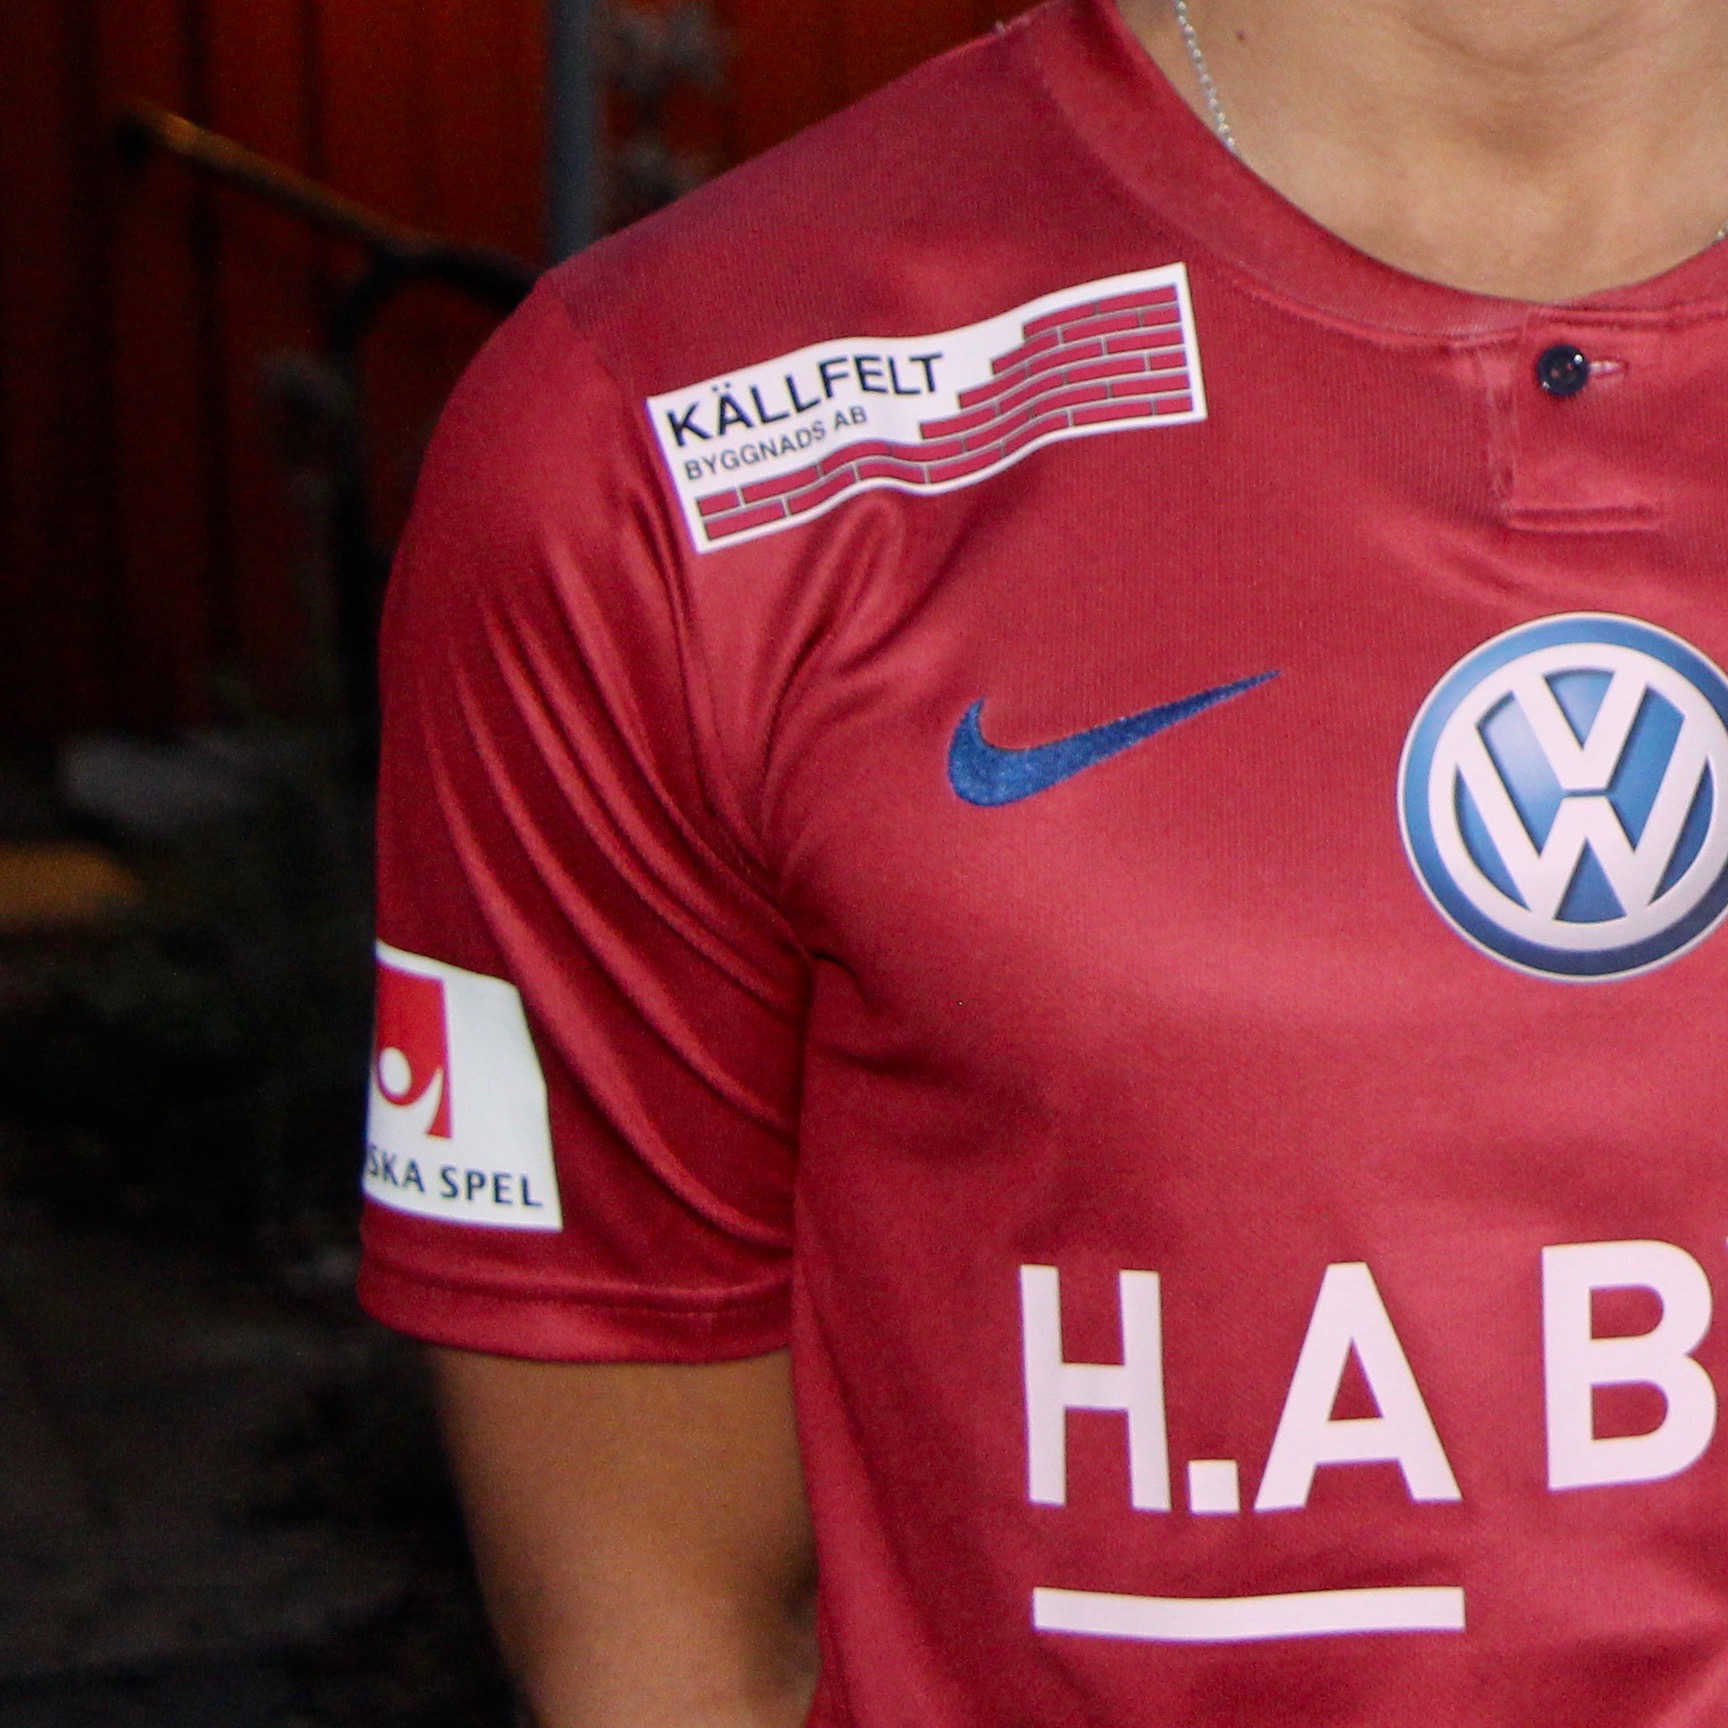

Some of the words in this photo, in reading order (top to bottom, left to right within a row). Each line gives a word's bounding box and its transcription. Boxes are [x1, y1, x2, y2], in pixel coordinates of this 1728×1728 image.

[665, 351, 945, 448] KÄLLFELT
[683, 419, 827, 482] BYGGNADS
[833, 404, 868, 434] AB
[364, 1143, 426, 1193] SKA
[440, 1162, 543, 1208] SPEL
[1018, 1260, 1464, 1515] H.A
